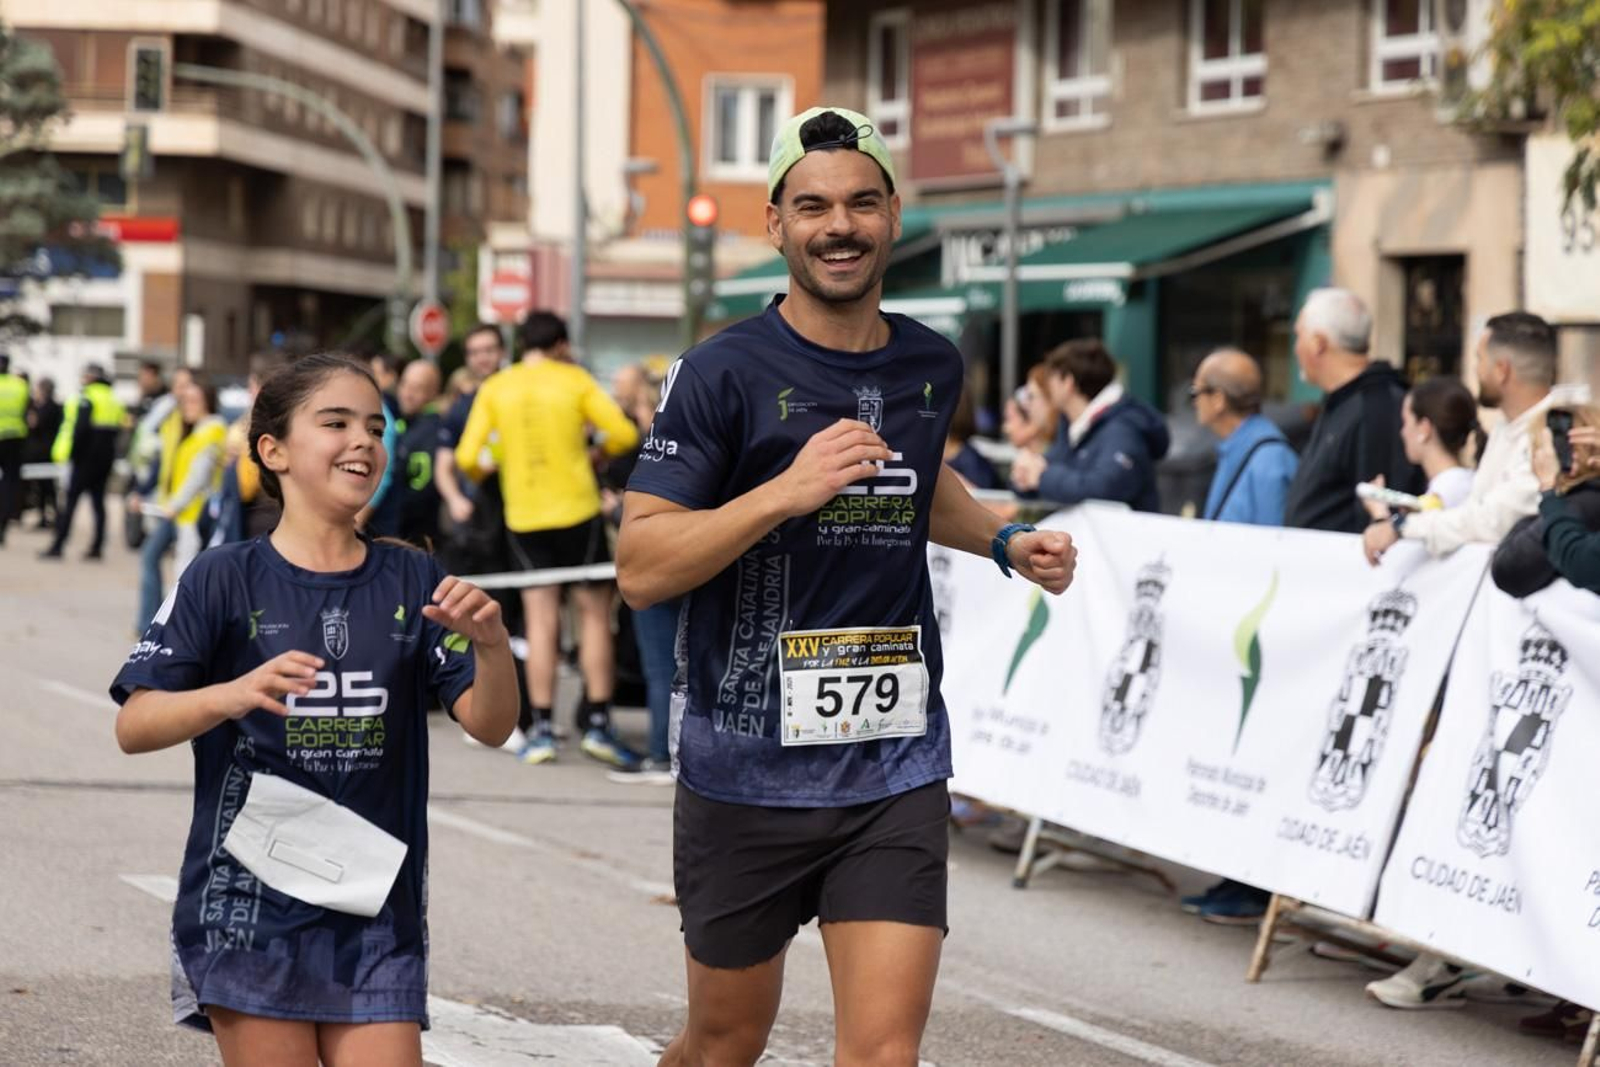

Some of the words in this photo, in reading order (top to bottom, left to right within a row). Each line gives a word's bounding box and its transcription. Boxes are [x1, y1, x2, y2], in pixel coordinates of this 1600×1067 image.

[818, 510, 915, 524] POPULAR
[818, 525, 828, 534] y
[831, 524, 861, 534] gran
[722, 646, 751, 705] SANTA
[738, 550, 759, 641] CATALINA
[821, 634, 873, 645] CARRERA
[873, 633, 913, 643] POPULAR
[786, 637, 819, 658] XXV
[821, 646, 830, 657] y
[837, 644, 867, 656] gran
[870, 641, 914, 652] caminata
[286, 670, 389, 717] 25
[743, 678, 762, 710] DE
[815, 672, 900, 718] 579
[285, 717, 385, 732] CARRERA
[286, 732, 385, 748] POPULAR
[286, 749, 297, 759] y
[300, 749, 332, 760] gran
[1317, 827, 1340, 852] DE
[1410, 855, 1468, 894] CIUDAD
[1466, 874, 1491, 902] DE
[206, 864, 231, 921] SANTA
[230, 897, 252, 922] DE
